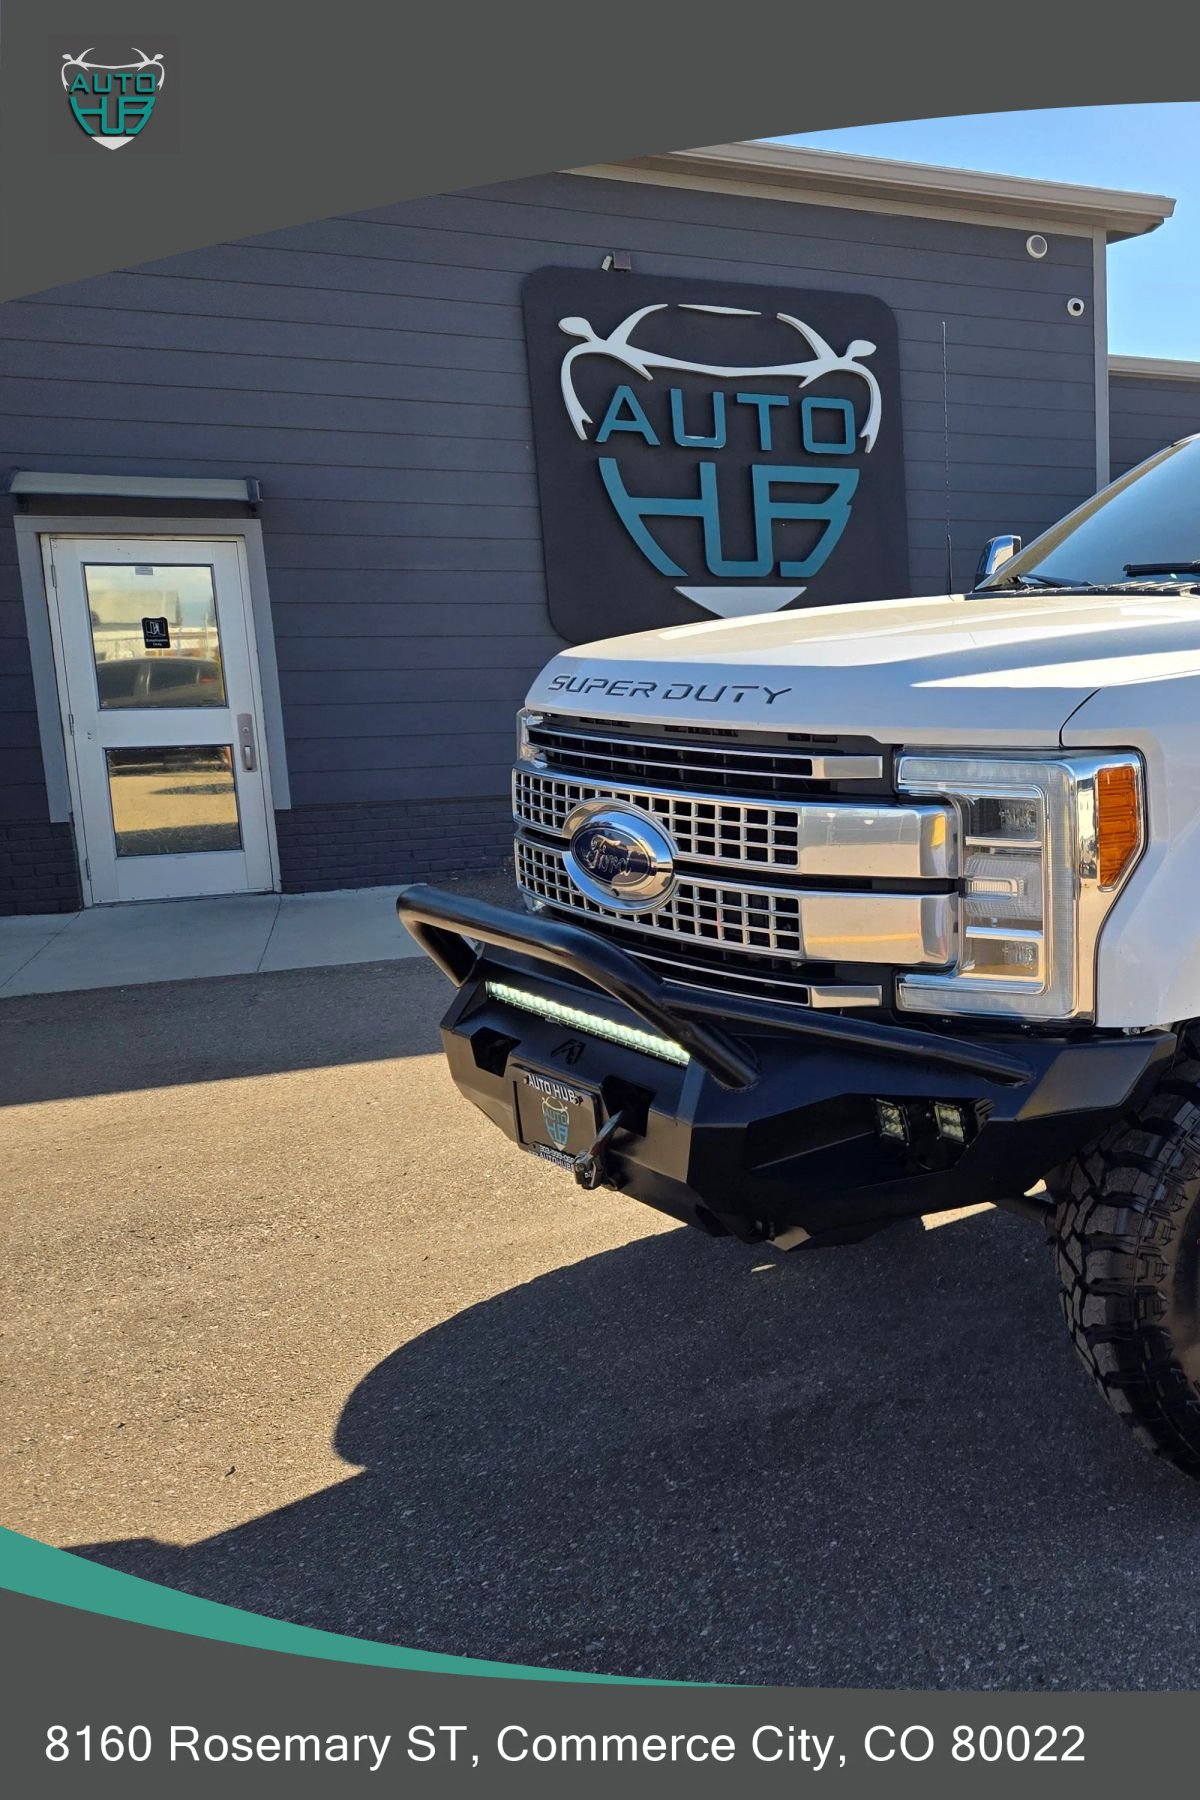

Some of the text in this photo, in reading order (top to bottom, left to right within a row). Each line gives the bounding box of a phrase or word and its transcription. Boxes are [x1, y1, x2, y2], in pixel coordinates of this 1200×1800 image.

[596, 385, 857, 455] AUTO
[598, 457, 861, 578] HUB
[548, 675, 793, 704] SUPER DUTY
[584, 833, 632, 876] Ford
[528, 1073, 575, 1103] AUTO HUB
[543, 1108, 568, 1125] AUTO
